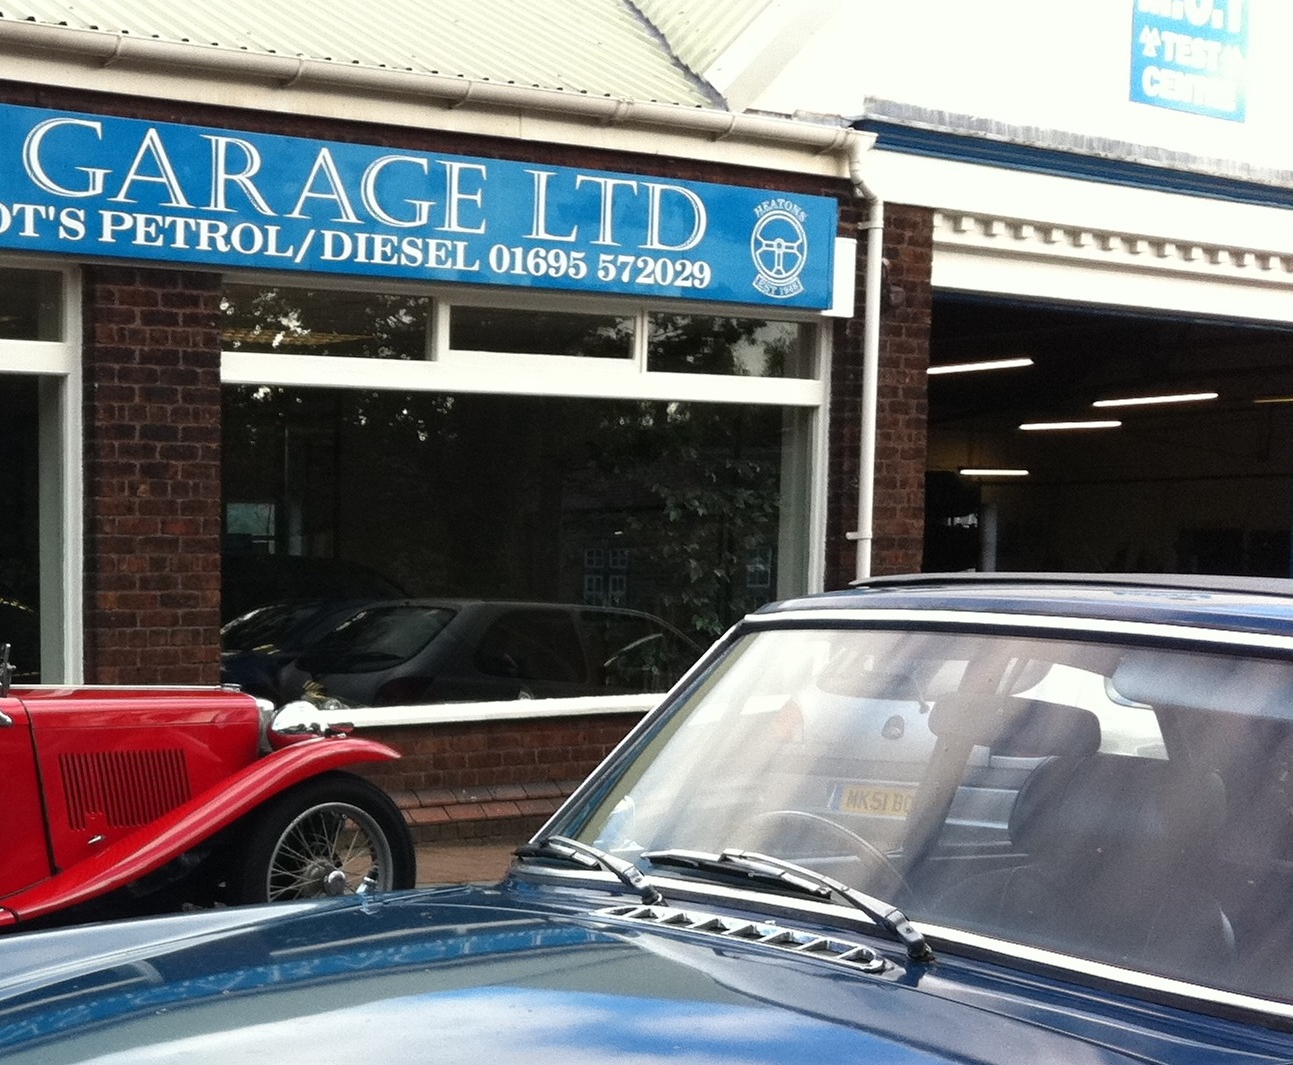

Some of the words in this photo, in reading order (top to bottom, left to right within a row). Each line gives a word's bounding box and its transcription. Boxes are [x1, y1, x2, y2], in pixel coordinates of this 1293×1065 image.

[1160, 30, 1222, 71] TEST
[1141, 65, 1238, 112] CENT
[22, 117, 487, 235] GARAGE
[522, 169, 708, 252] LTD
[753, 198, 808, 223] HEATONS
[98, 209, 481, 272] PETROL/DIESEL
[488, 243, 589, 280] 01695
[596, 253, 712, 289] 572029
[758, 278, 777, 295] EST
